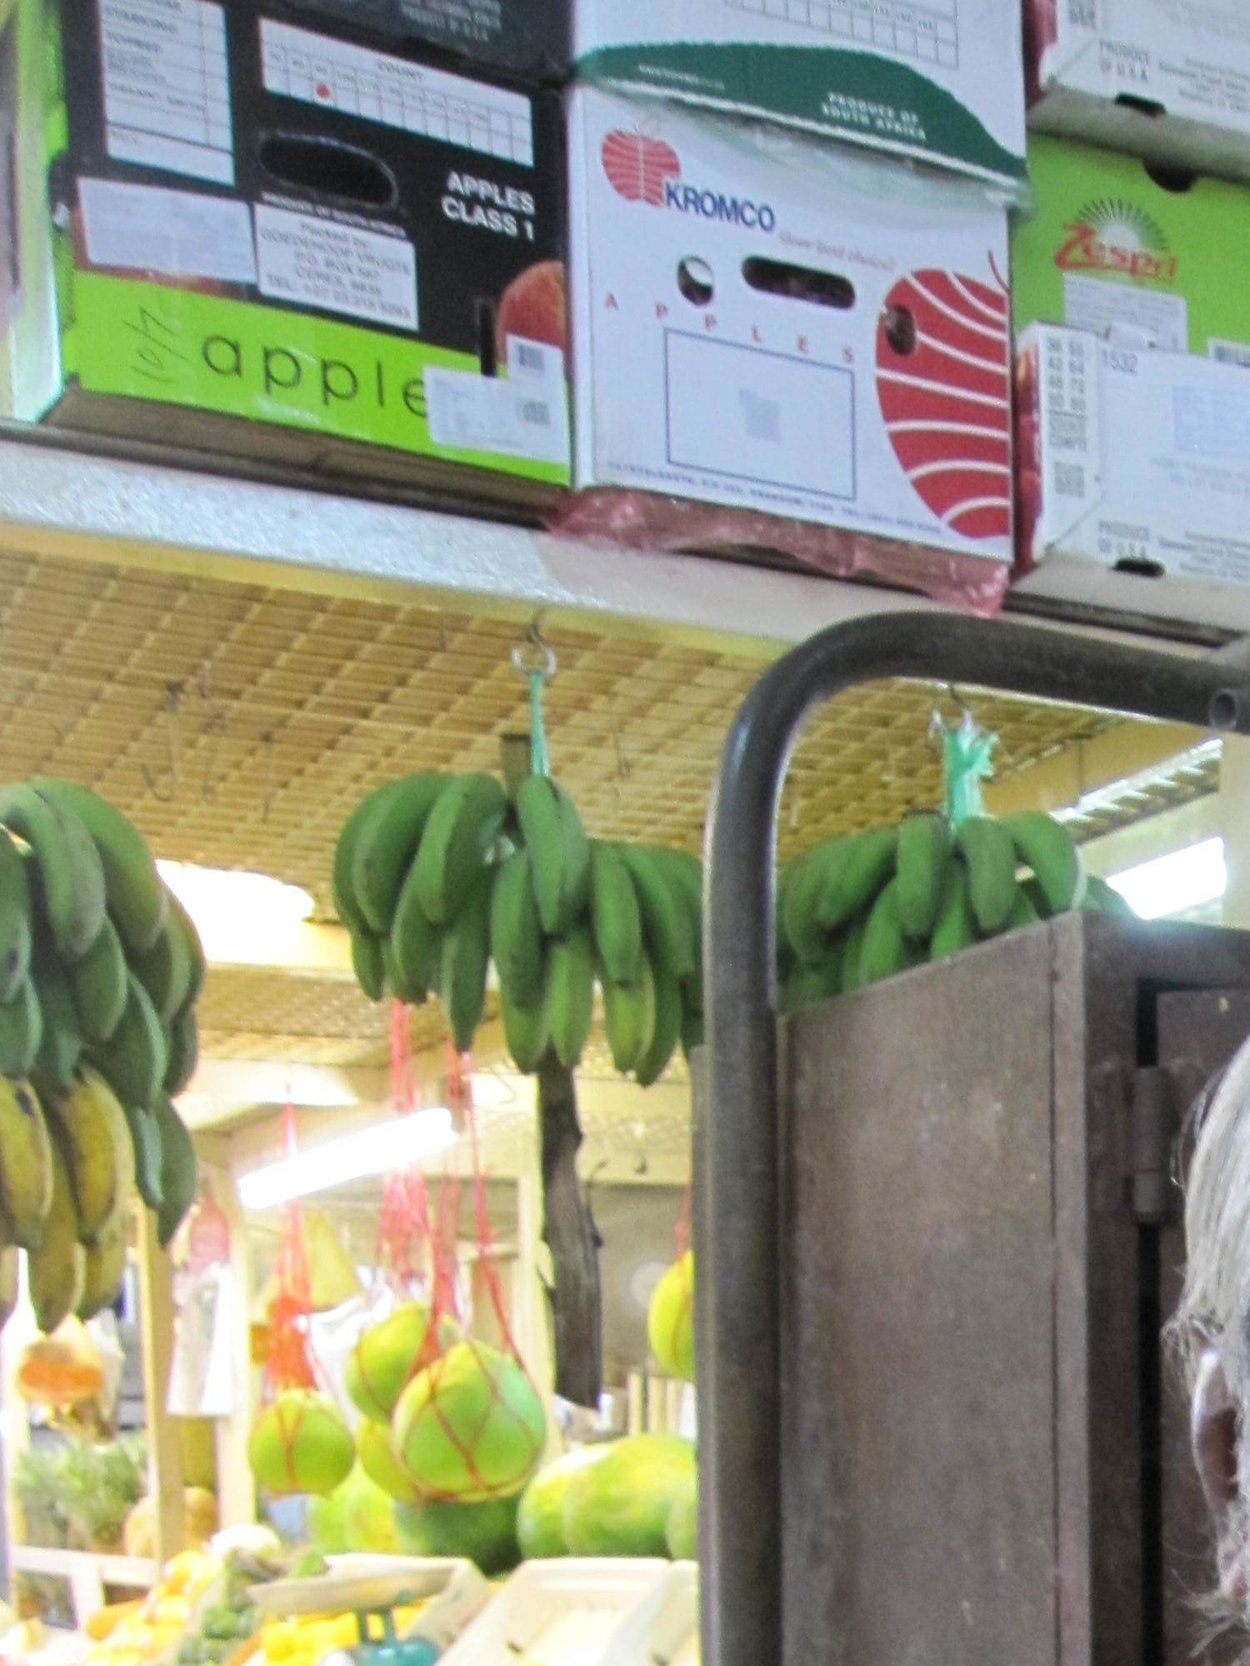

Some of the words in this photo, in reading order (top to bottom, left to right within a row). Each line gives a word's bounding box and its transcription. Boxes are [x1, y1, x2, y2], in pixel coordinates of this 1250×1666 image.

[820, 101, 870, 126] SOUTH
[875, 115, 927, 141] AFRICA
[446, 170, 536, 216] APPLES
[664, 180, 776, 232] KROMCO
[441, 195, 518, 238] CLASS
[1054, 220, 1178, 288] Zespri
[1101, 347, 1139, 375] 1532
